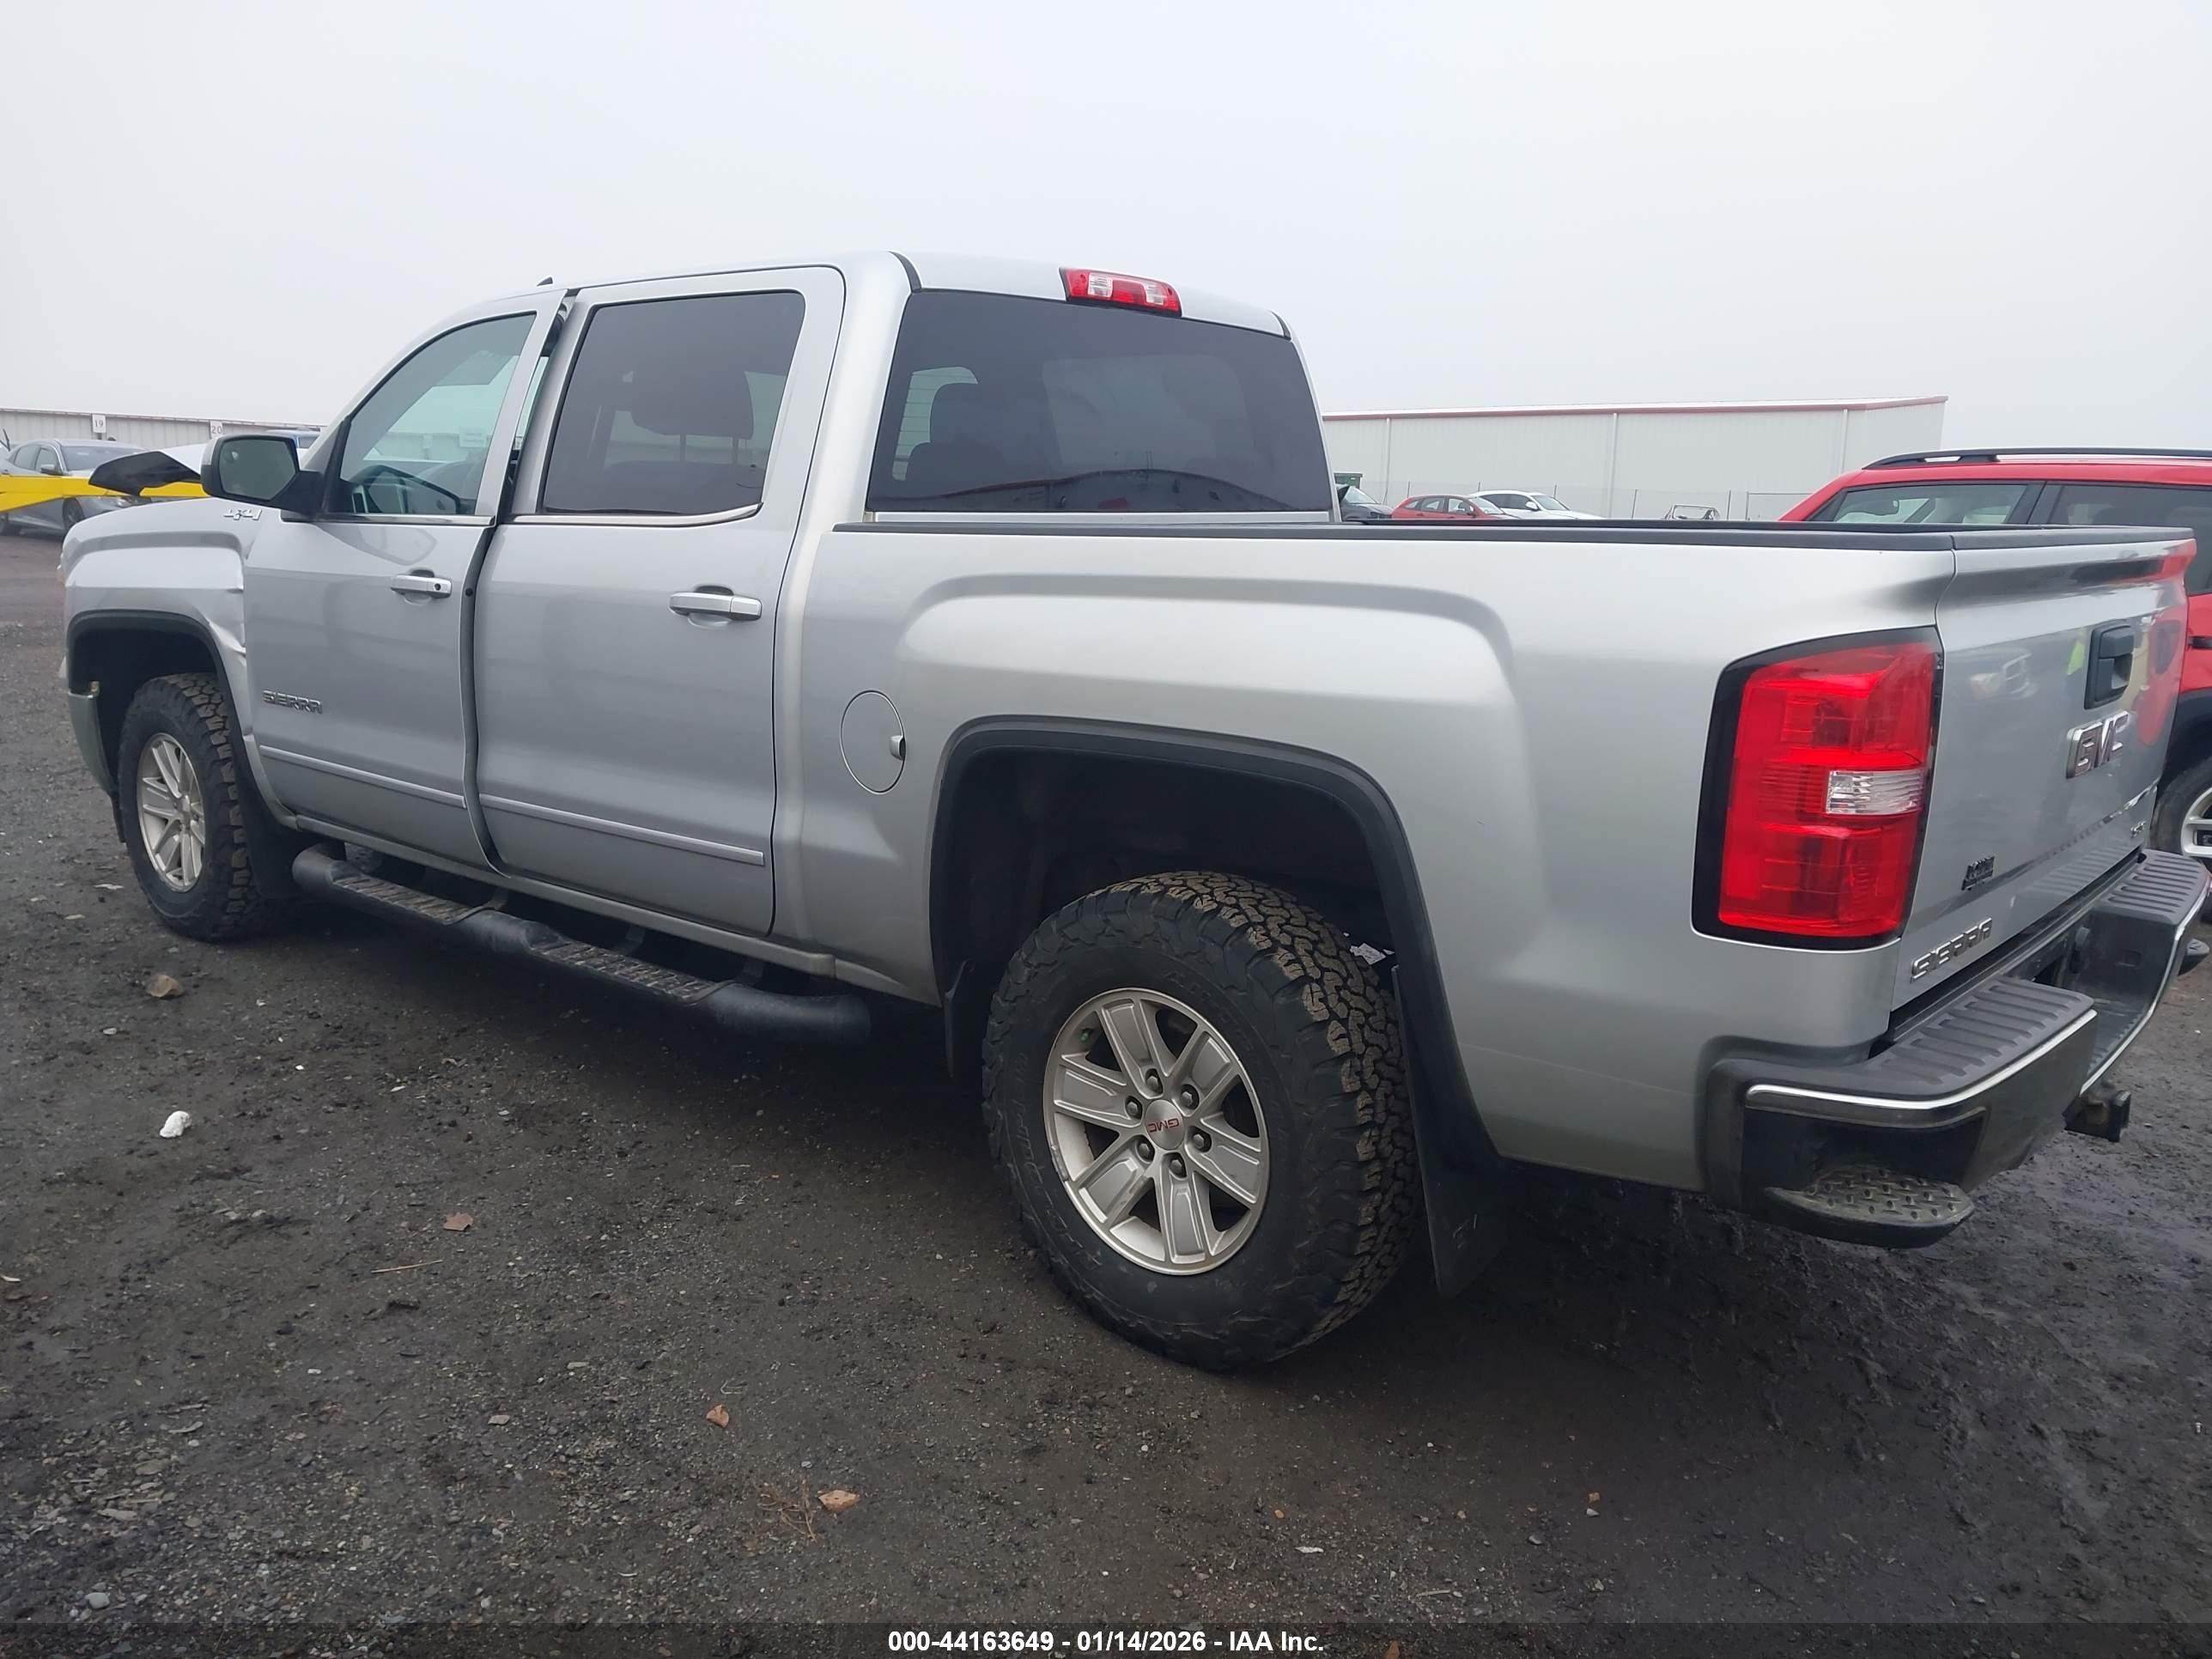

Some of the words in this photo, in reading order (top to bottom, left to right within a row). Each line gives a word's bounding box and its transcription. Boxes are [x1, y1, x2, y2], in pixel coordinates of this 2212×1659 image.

[94, 419, 104, 428] 19
[211, 425, 222, 434] 20
[262, 690, 323, 714] SIERRA
[2066, 710, 2130, 779] GMC
[1147, 1118, 1179, 1133] GMC
